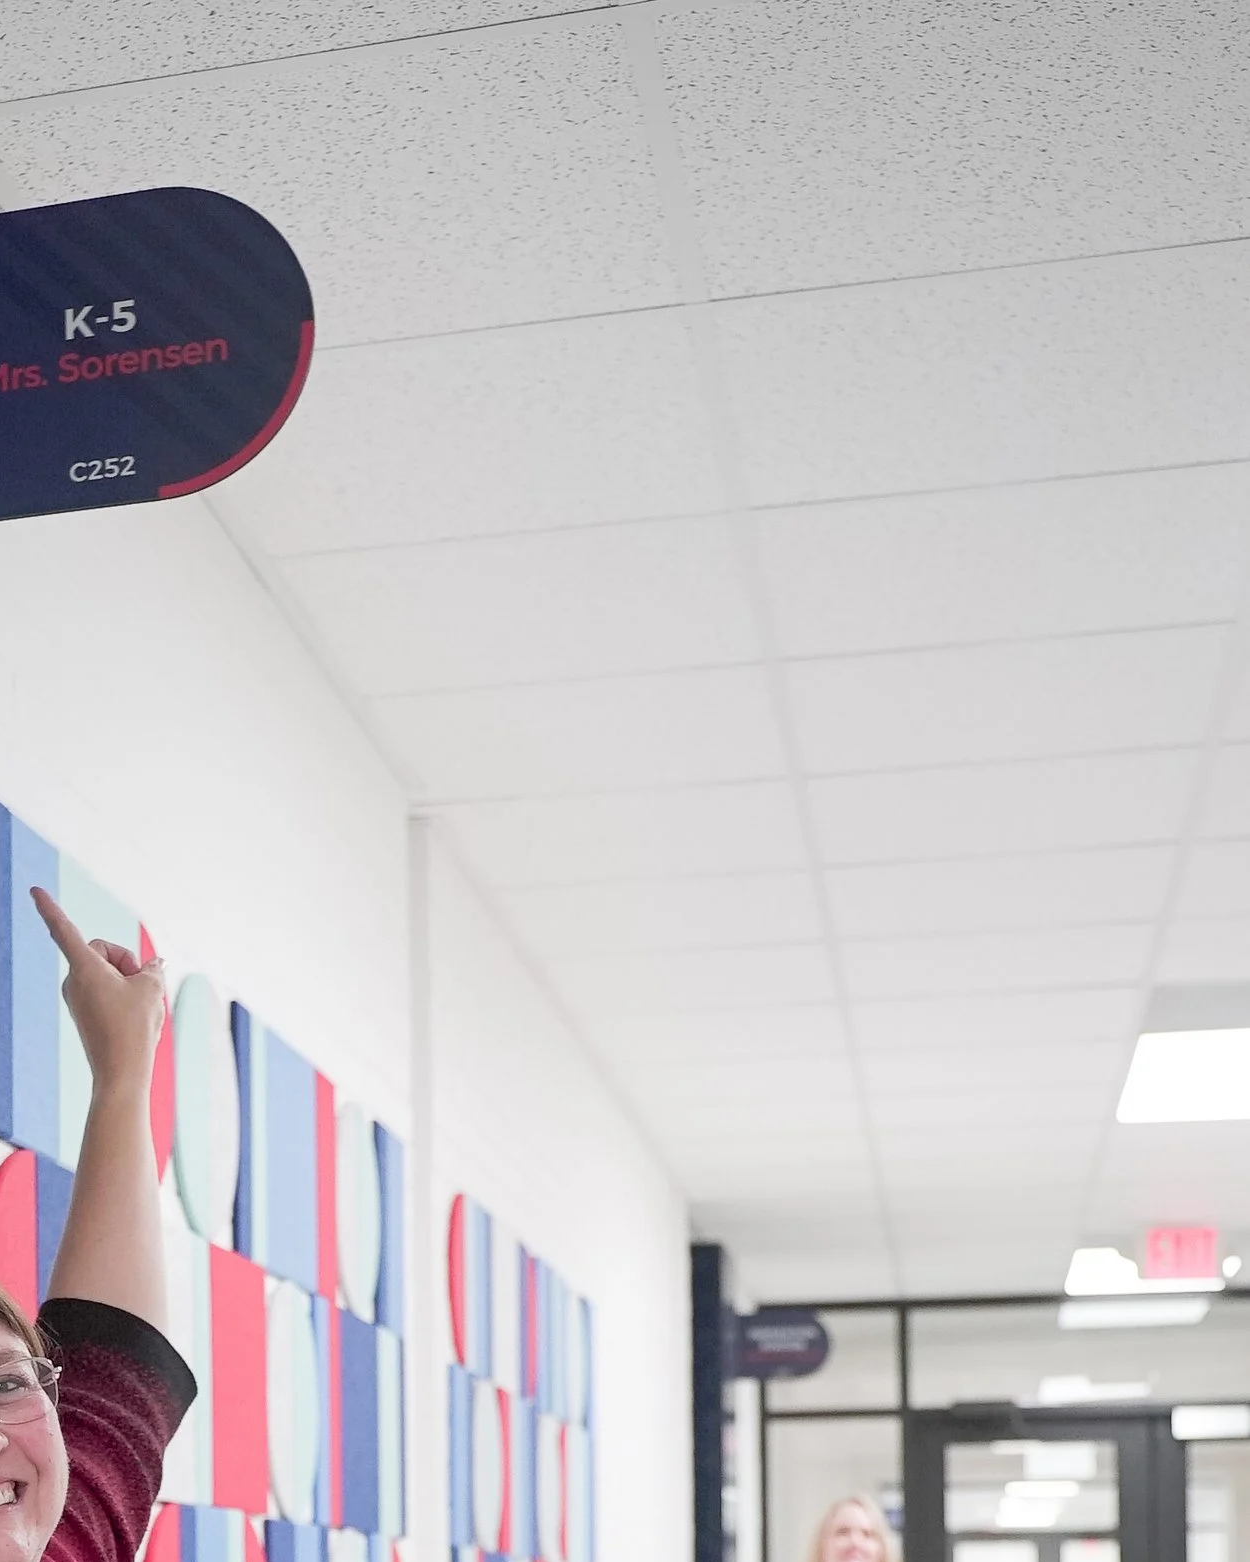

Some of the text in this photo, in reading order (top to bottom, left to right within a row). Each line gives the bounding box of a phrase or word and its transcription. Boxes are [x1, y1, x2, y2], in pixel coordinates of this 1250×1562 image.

[63, 299, 137, 341] K-5
[59, 338, 229, 383] Sorensen
[68, 455, 137, 483] C252
